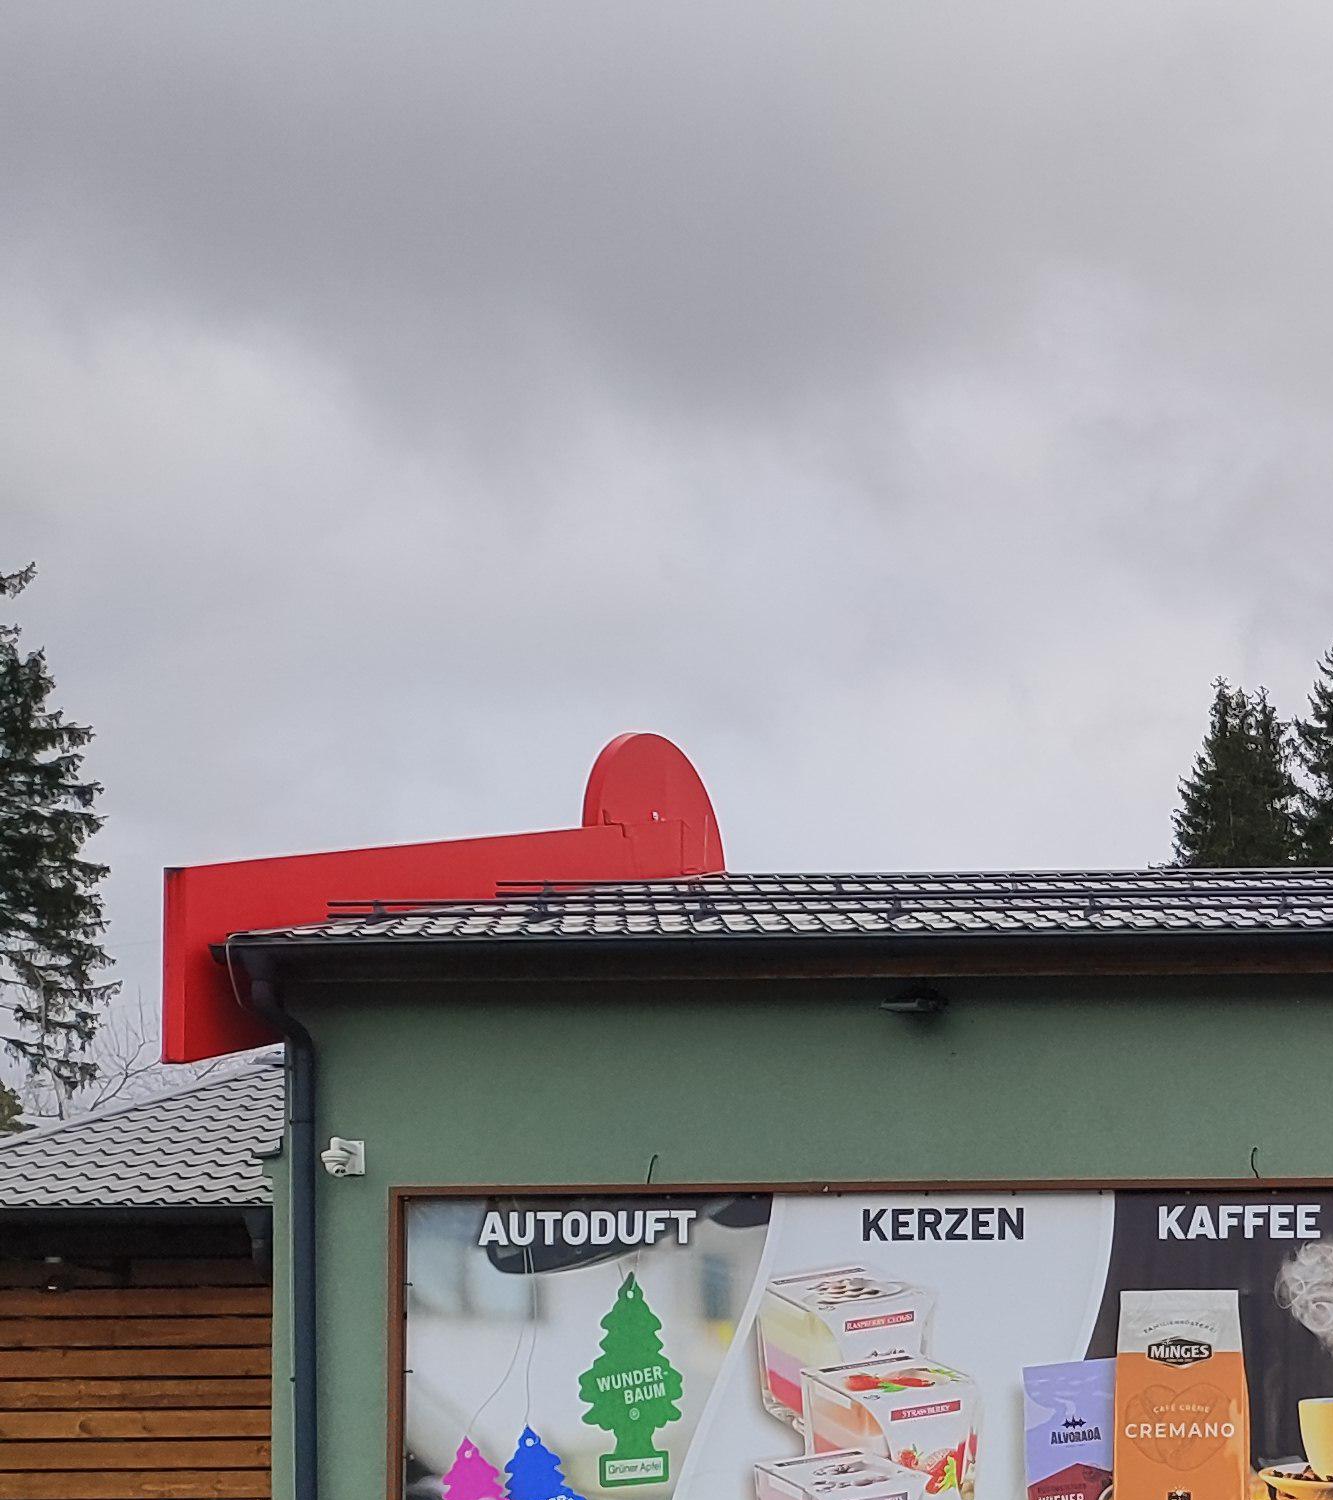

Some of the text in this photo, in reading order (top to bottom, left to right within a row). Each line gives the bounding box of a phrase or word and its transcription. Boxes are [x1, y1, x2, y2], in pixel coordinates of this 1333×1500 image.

[478, 1208, 698, 1248] AUTODUFT
[861, 1206, 1026, 1243] KERZEN
[1157, 1203, 1323, 1241] KAFFEE
[596, 1365, 668, 1393] WUNDER-
[623, 1382, 666, 1405] BAUM
[1050, 1426, 1102, 1445] ALVORADA
[1124, 1422, 1236, 1439] CREMANO
